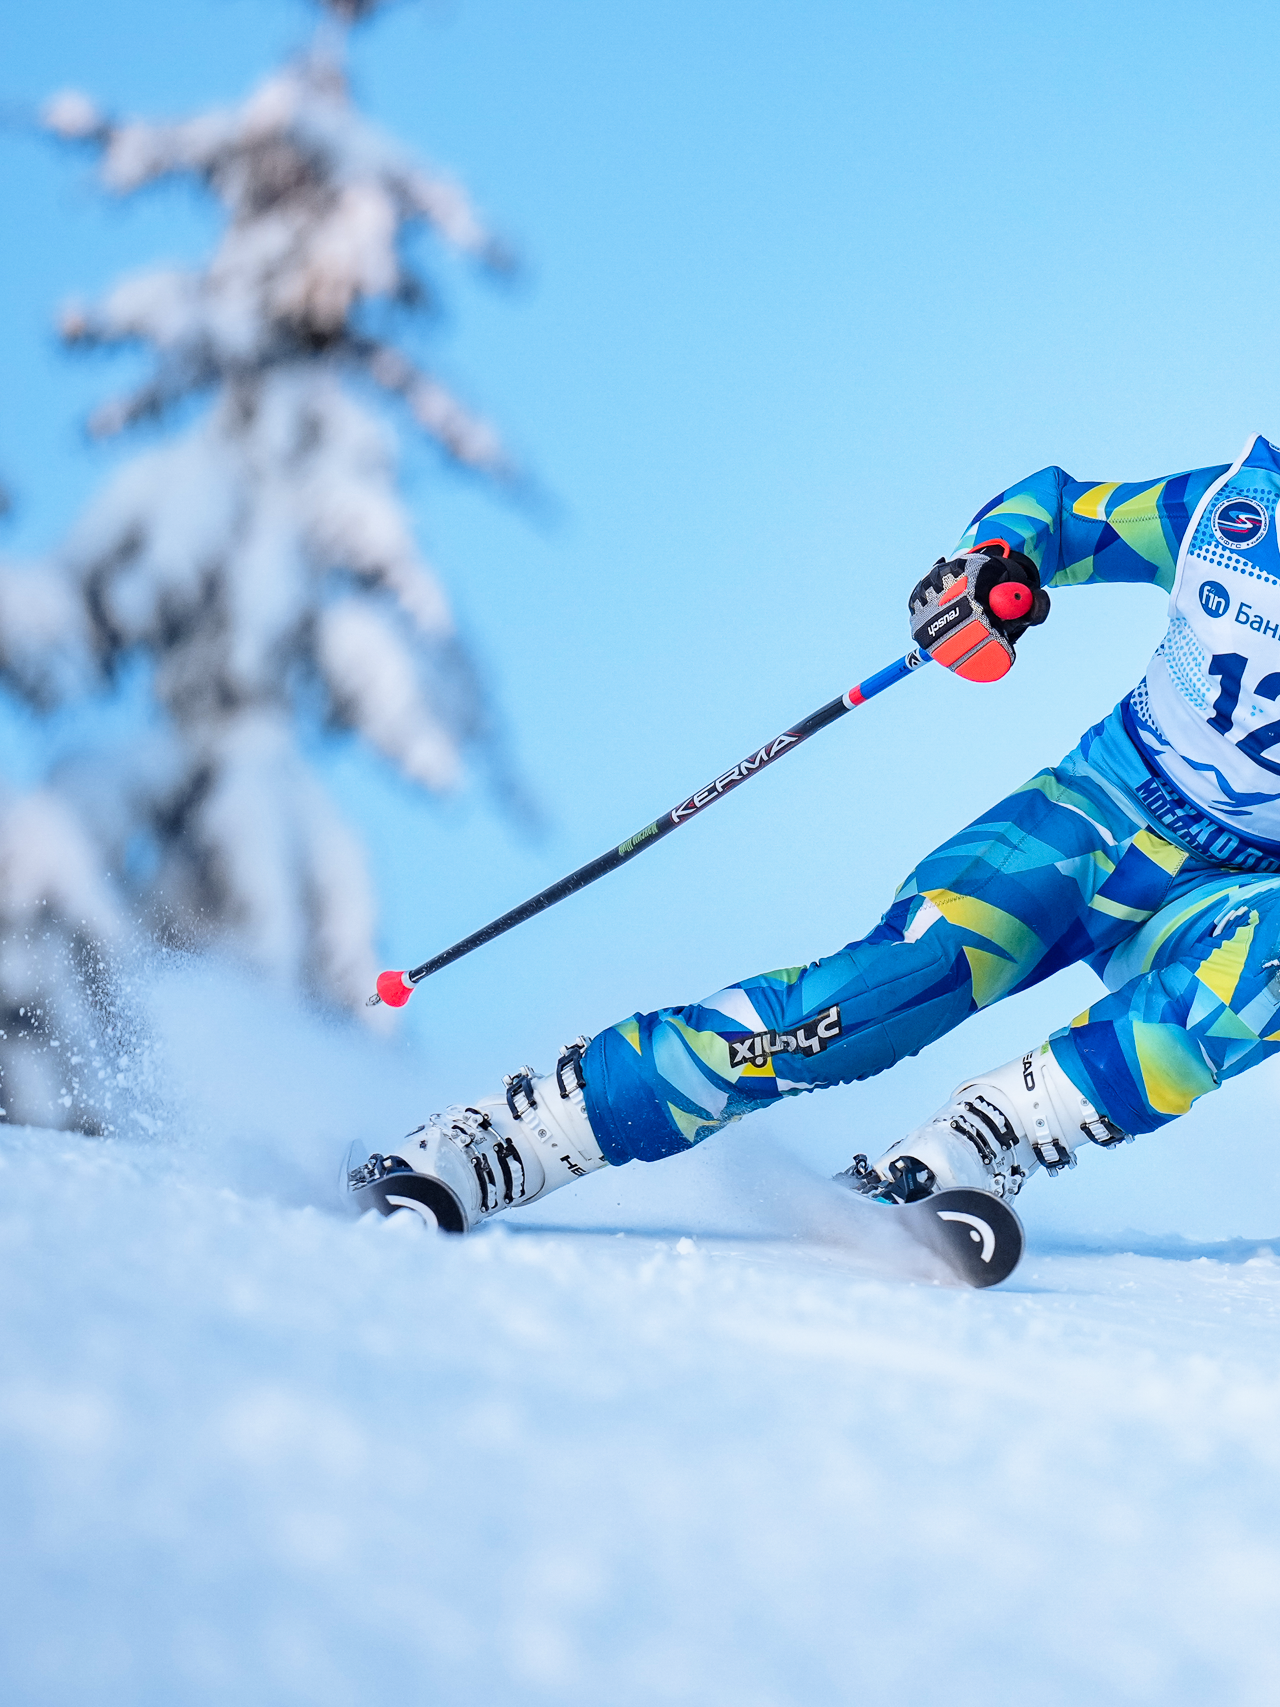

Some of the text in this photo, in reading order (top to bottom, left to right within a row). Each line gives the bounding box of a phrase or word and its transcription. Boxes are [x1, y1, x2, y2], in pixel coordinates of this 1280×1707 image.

[1202, 585, 1226, 615] fin
[928, 606, 960, 637] reusch
[670, 732, 798, 824] KERMA
